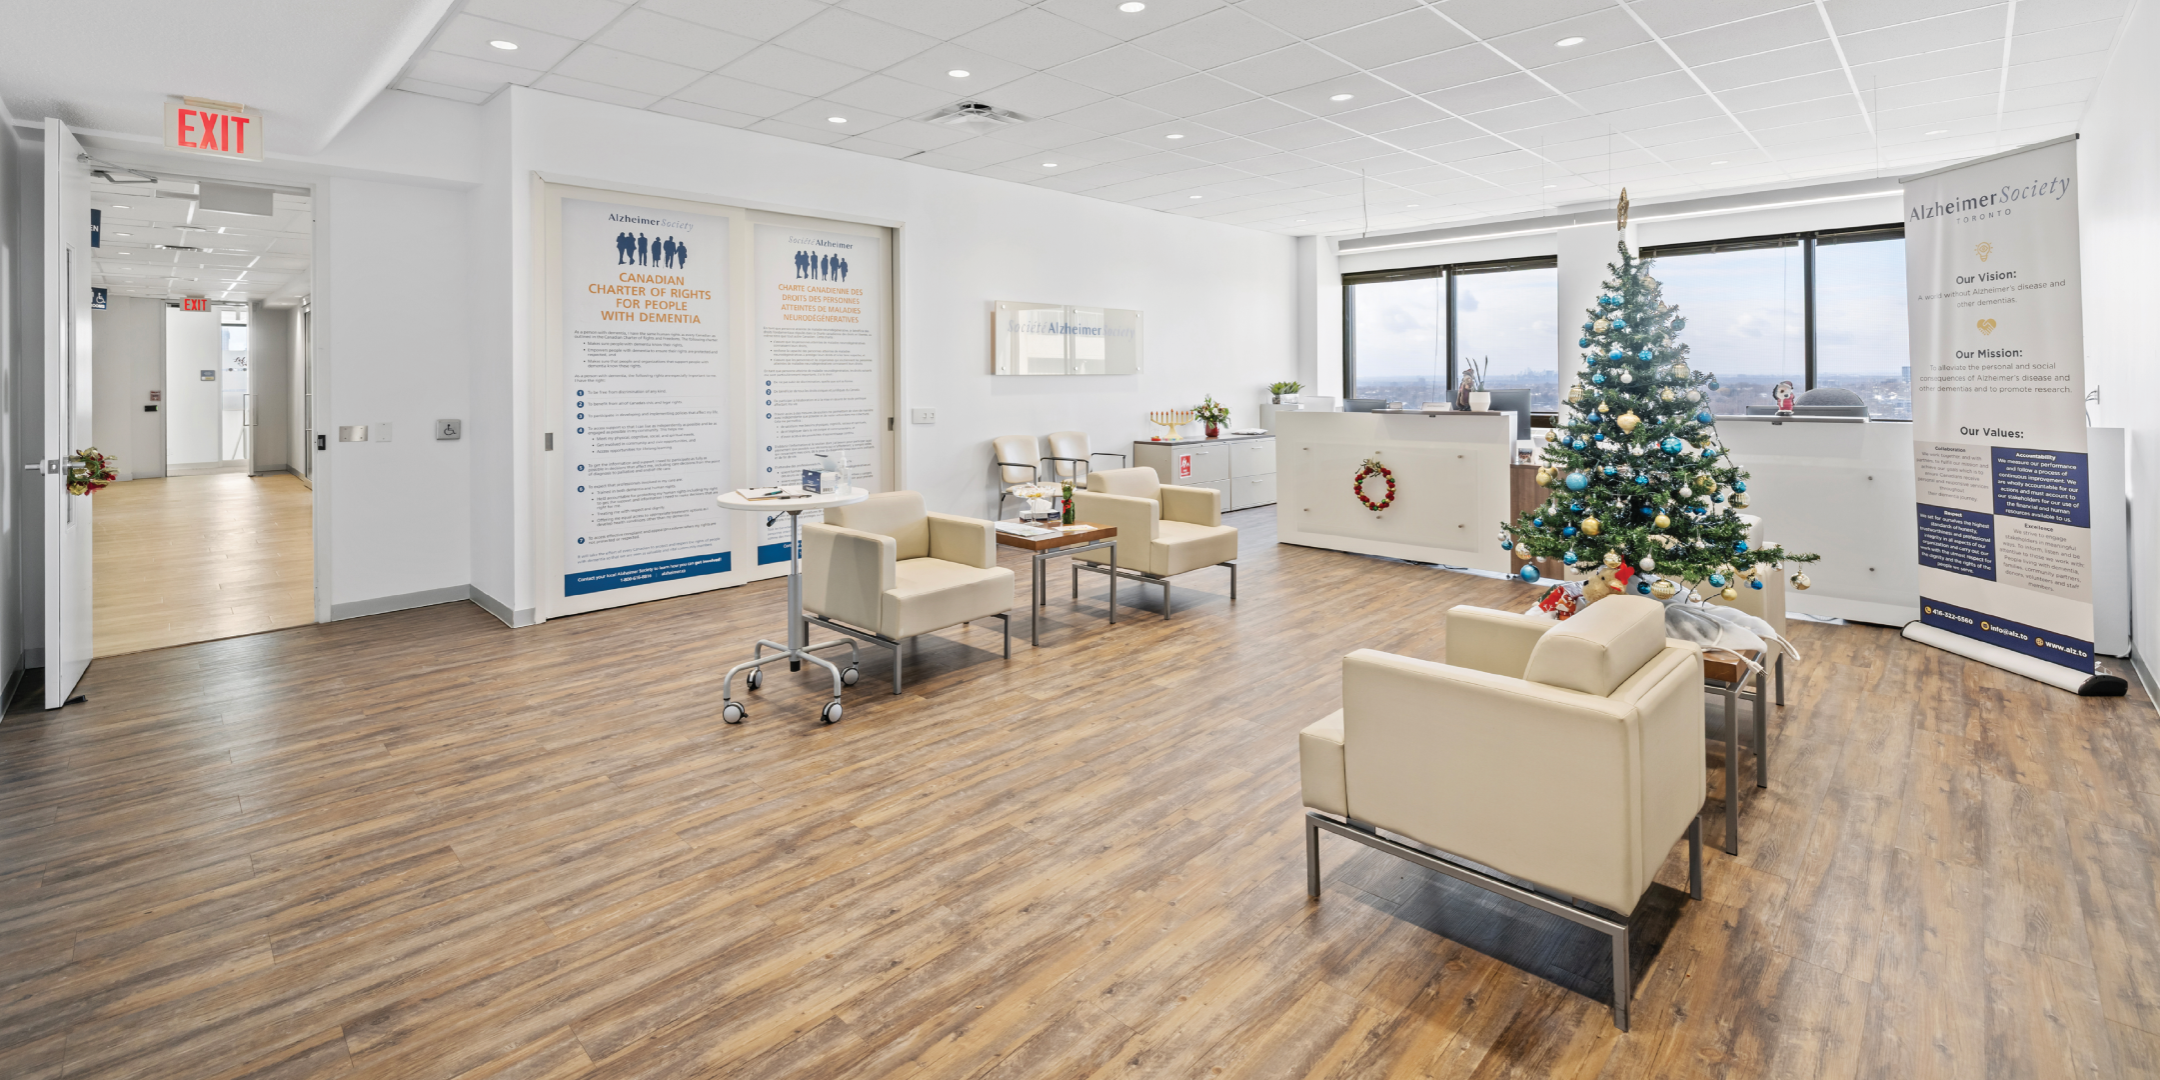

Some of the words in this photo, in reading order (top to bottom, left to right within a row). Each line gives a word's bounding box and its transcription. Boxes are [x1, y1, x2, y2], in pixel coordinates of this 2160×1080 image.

[178, 108, 249, 154] EXIT
[1957, 209, 2011, 224] TORONTO
[619, 273, 684, 286] CANADIAN
[1956, 275, 1975, 284] Our
[1978, 271, 2017, 282] Vision:
[589, 284, 646, 296] CHARTER
[650, 288, 666, 297] OF
[671, 289, 711, 300] RIGHTS
[778, 284, 805, 292] CHARTE
[807, 286, 849, 295] CANADIENNE
[1918, 293, 1923, 301] A
[1944, 289, 1971, 298] without
[1972, 285, 2016, 295] Alzheimer's
[2017, 283, 2047, 291] disease
[2049, 279, 2066, 288] and
[616, 299, 640, 309] FOR
[645, 300, 687, 310] PEOPLE
[782, 294, 807, 302] DROITS
[809, 295, 821, 303] DES
[823, 296, 860, 304] PERSONNES
[1956, 300, 1975, 308] other
[1977, 297, 2017, 306] dementias.
[184, 299, 207, 311] EXIT
[781, 304, 816, 312] ATTEINTES
[828, 306, 861, 314] MALADIES
[601, 311, 634, 321] WITH
[639, 313, 701, 324] DEMENTIA
[1956, 350, 1974, 358] Our
[1978, 349, 2022, 358] Mission:
[1938, 363, 1966, 371] alleviate
[1968, 363, 1980, 371] the
[1981, 363, 2013, 372] personal
[2015, 362, 2030, 370] and
[2032, 362, 2056, 370] social
[1920, 376, 1966, 384] consequences
[1967, 374, 1975, 382] of
[1977, 374, 2020, 382] Alzheimer's
[2021, 374, 2052, 382] disease
[2054, 374, 2070, 382] and
[1919, 384, 1935, 392] other
[1999, 385, 2032, 394] promote
[2034, 385, 2072, 393] research.
[1960, 427, 1979, 435] Our
[1983, 428, 2023, 438] Values:
[2045, 542, 2077, 550] meaningful
[1991, 625, 2028, 640] info@alz.to
[2046, 641, 2087, 658] www.alz.to
